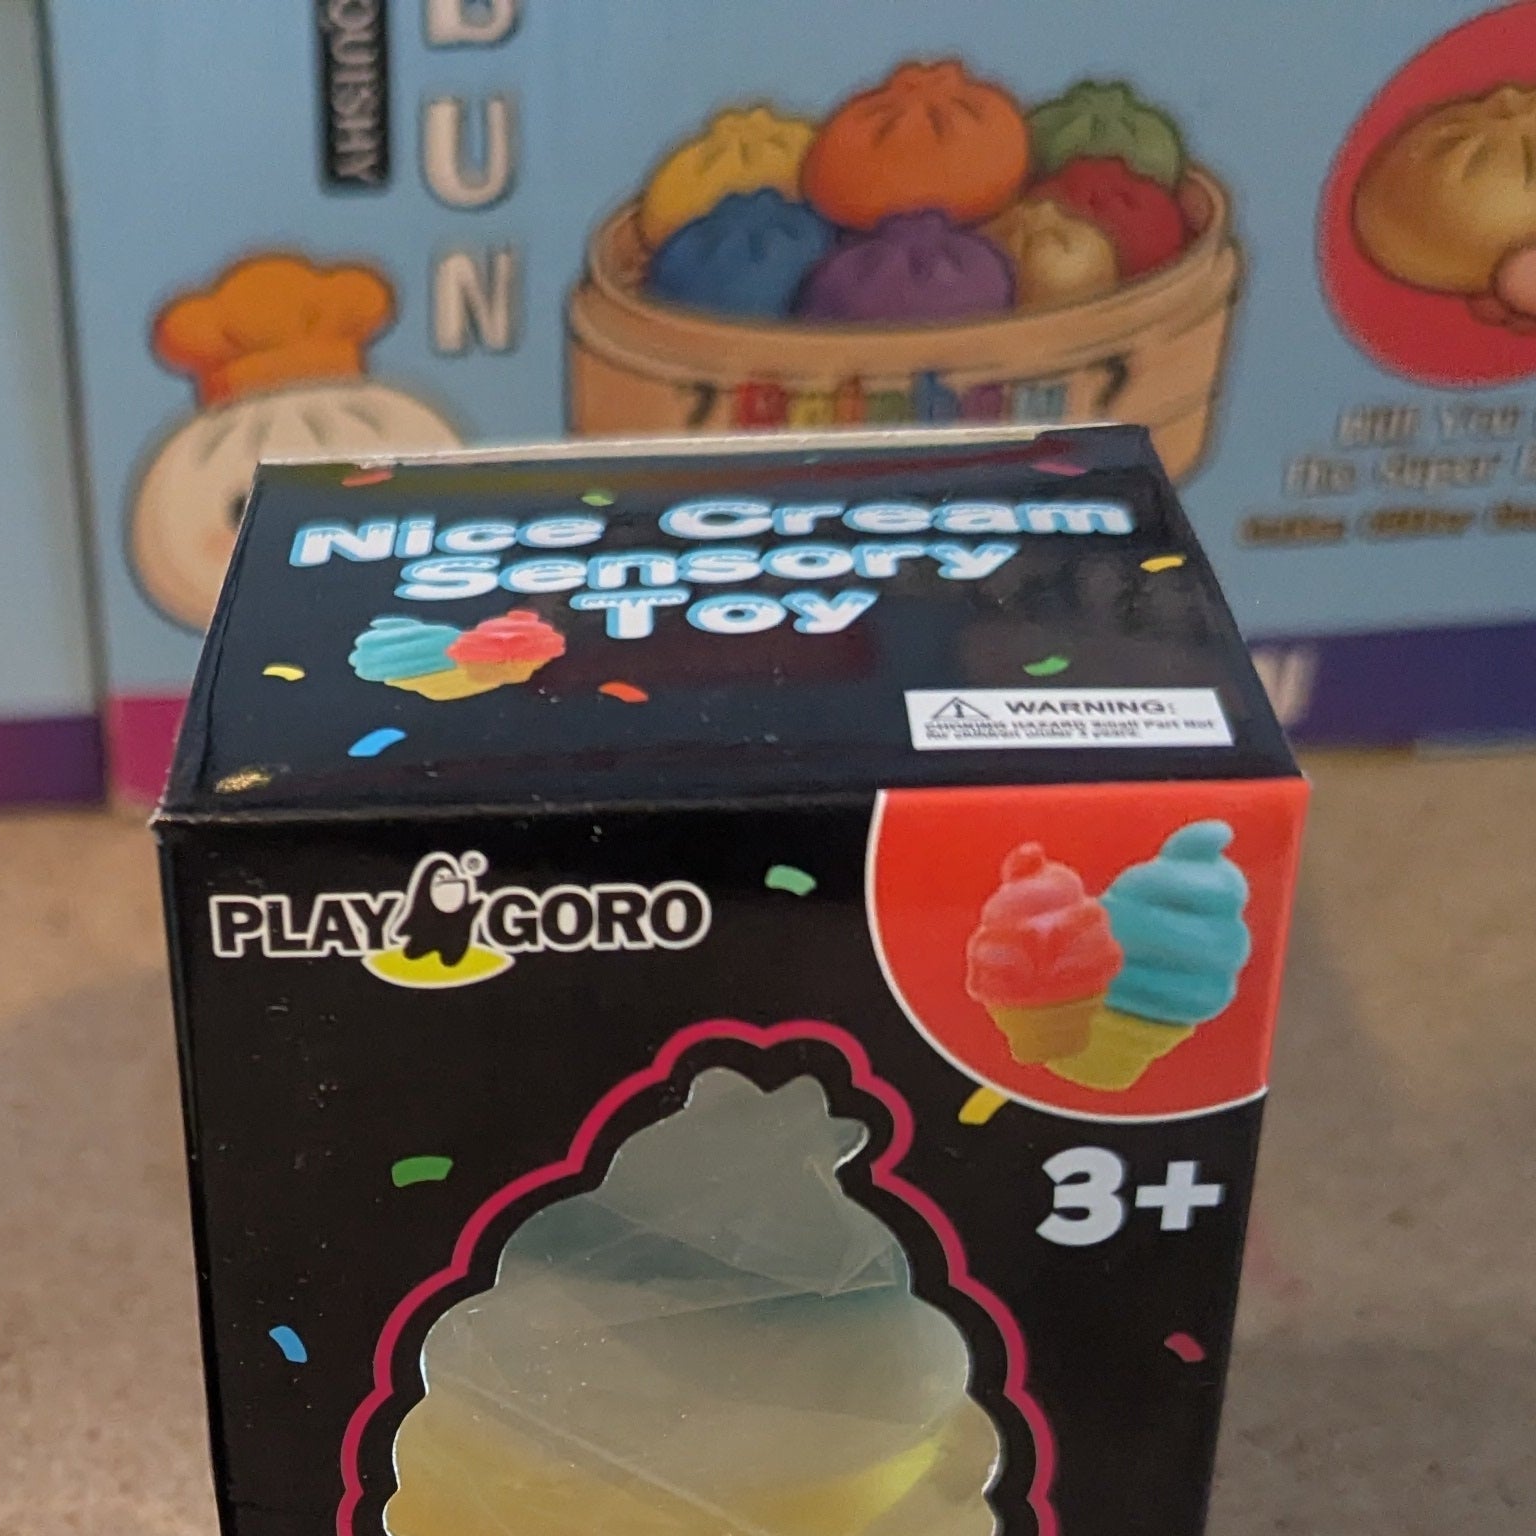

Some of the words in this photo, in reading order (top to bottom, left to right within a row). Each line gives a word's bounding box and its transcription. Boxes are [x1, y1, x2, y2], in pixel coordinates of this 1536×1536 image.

[289, 511, 608, 568] Nice
[658, 499, 1135, 540] Cream
[395, 541, 1020, 600] Sensory
[570, 590, 881, 639] Toy
[1005, 699, 1176, 716] WARNING:
[209, 893, 405, 957] PLAY
[486, 881, 712, 951] GORO
[1035, 1146, 1225, 1246] 3+
